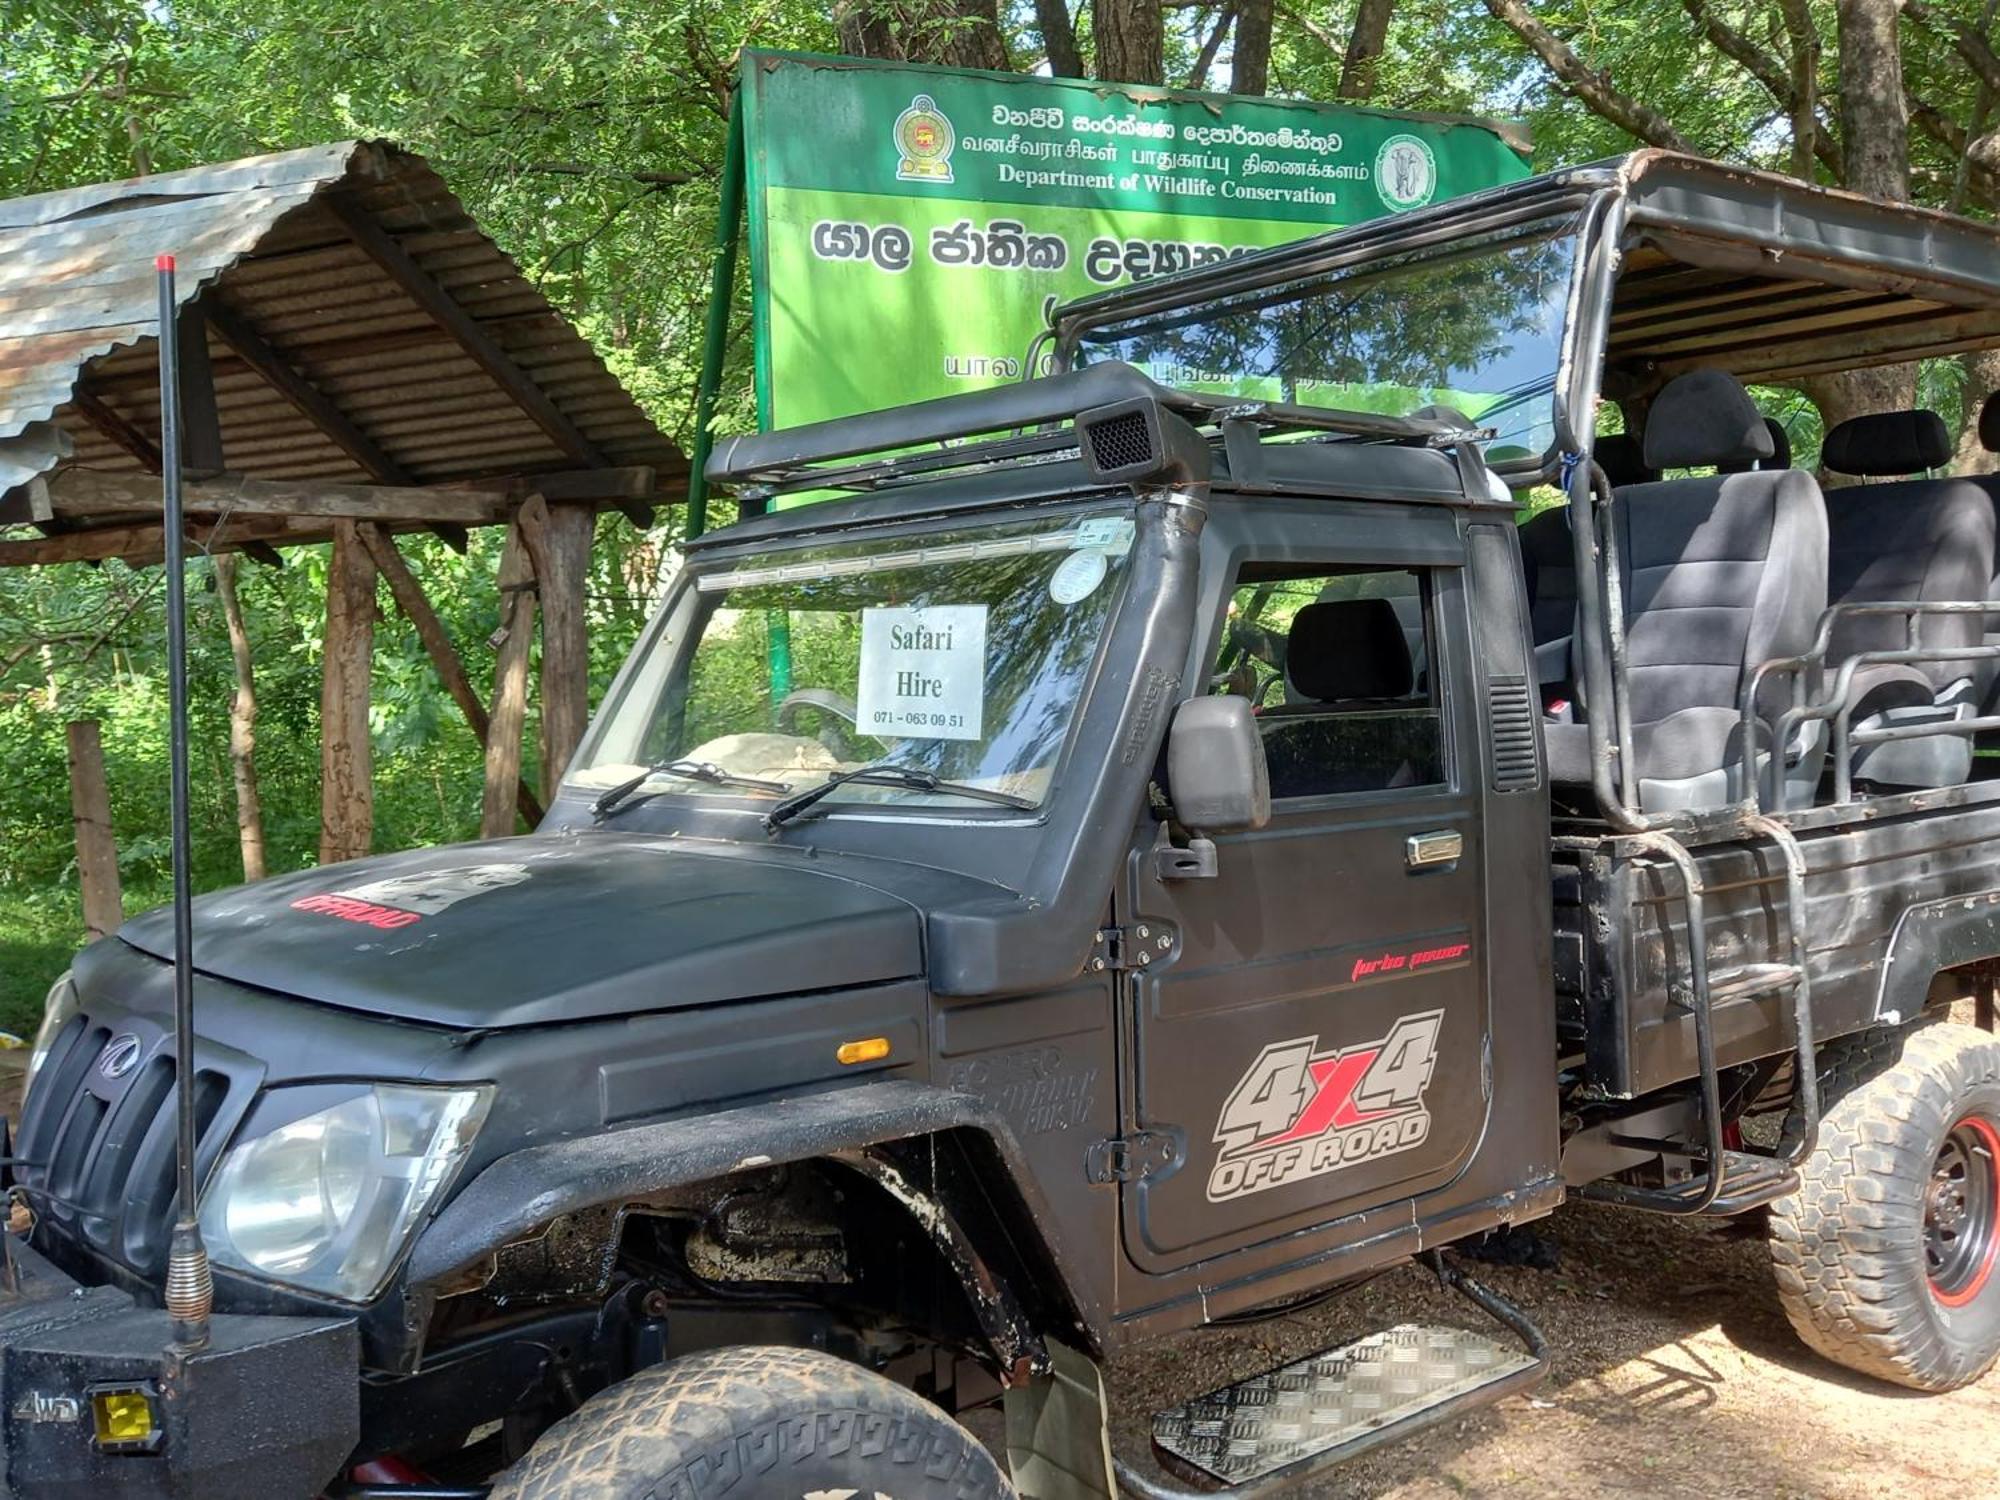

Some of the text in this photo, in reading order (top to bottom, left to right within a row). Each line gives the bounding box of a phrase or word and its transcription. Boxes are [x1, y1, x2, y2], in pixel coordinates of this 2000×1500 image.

[1132, 149, 1230, 175] பாதுகாப்பு
[1242, 153, 1369, 180] திணைக்களம்
[998, 163, 1336, 205] Department of Wildlife Conservation
[813, 221, 911, 273] යාල
[931, 219, 1068, 271] ජාතික
[945, 354, 1020, 379] யால
[890, 624, 953, 651] Safari
[896, 671, 943, 698] Hire
[873, 711, 893, 724] 071
[905, 712, 928, 725] 063
[930, 713, 946, 726] 09
[949, 714, 964, 727] 51
[1207, 1111, 1430, 1199] OFF ROAD
